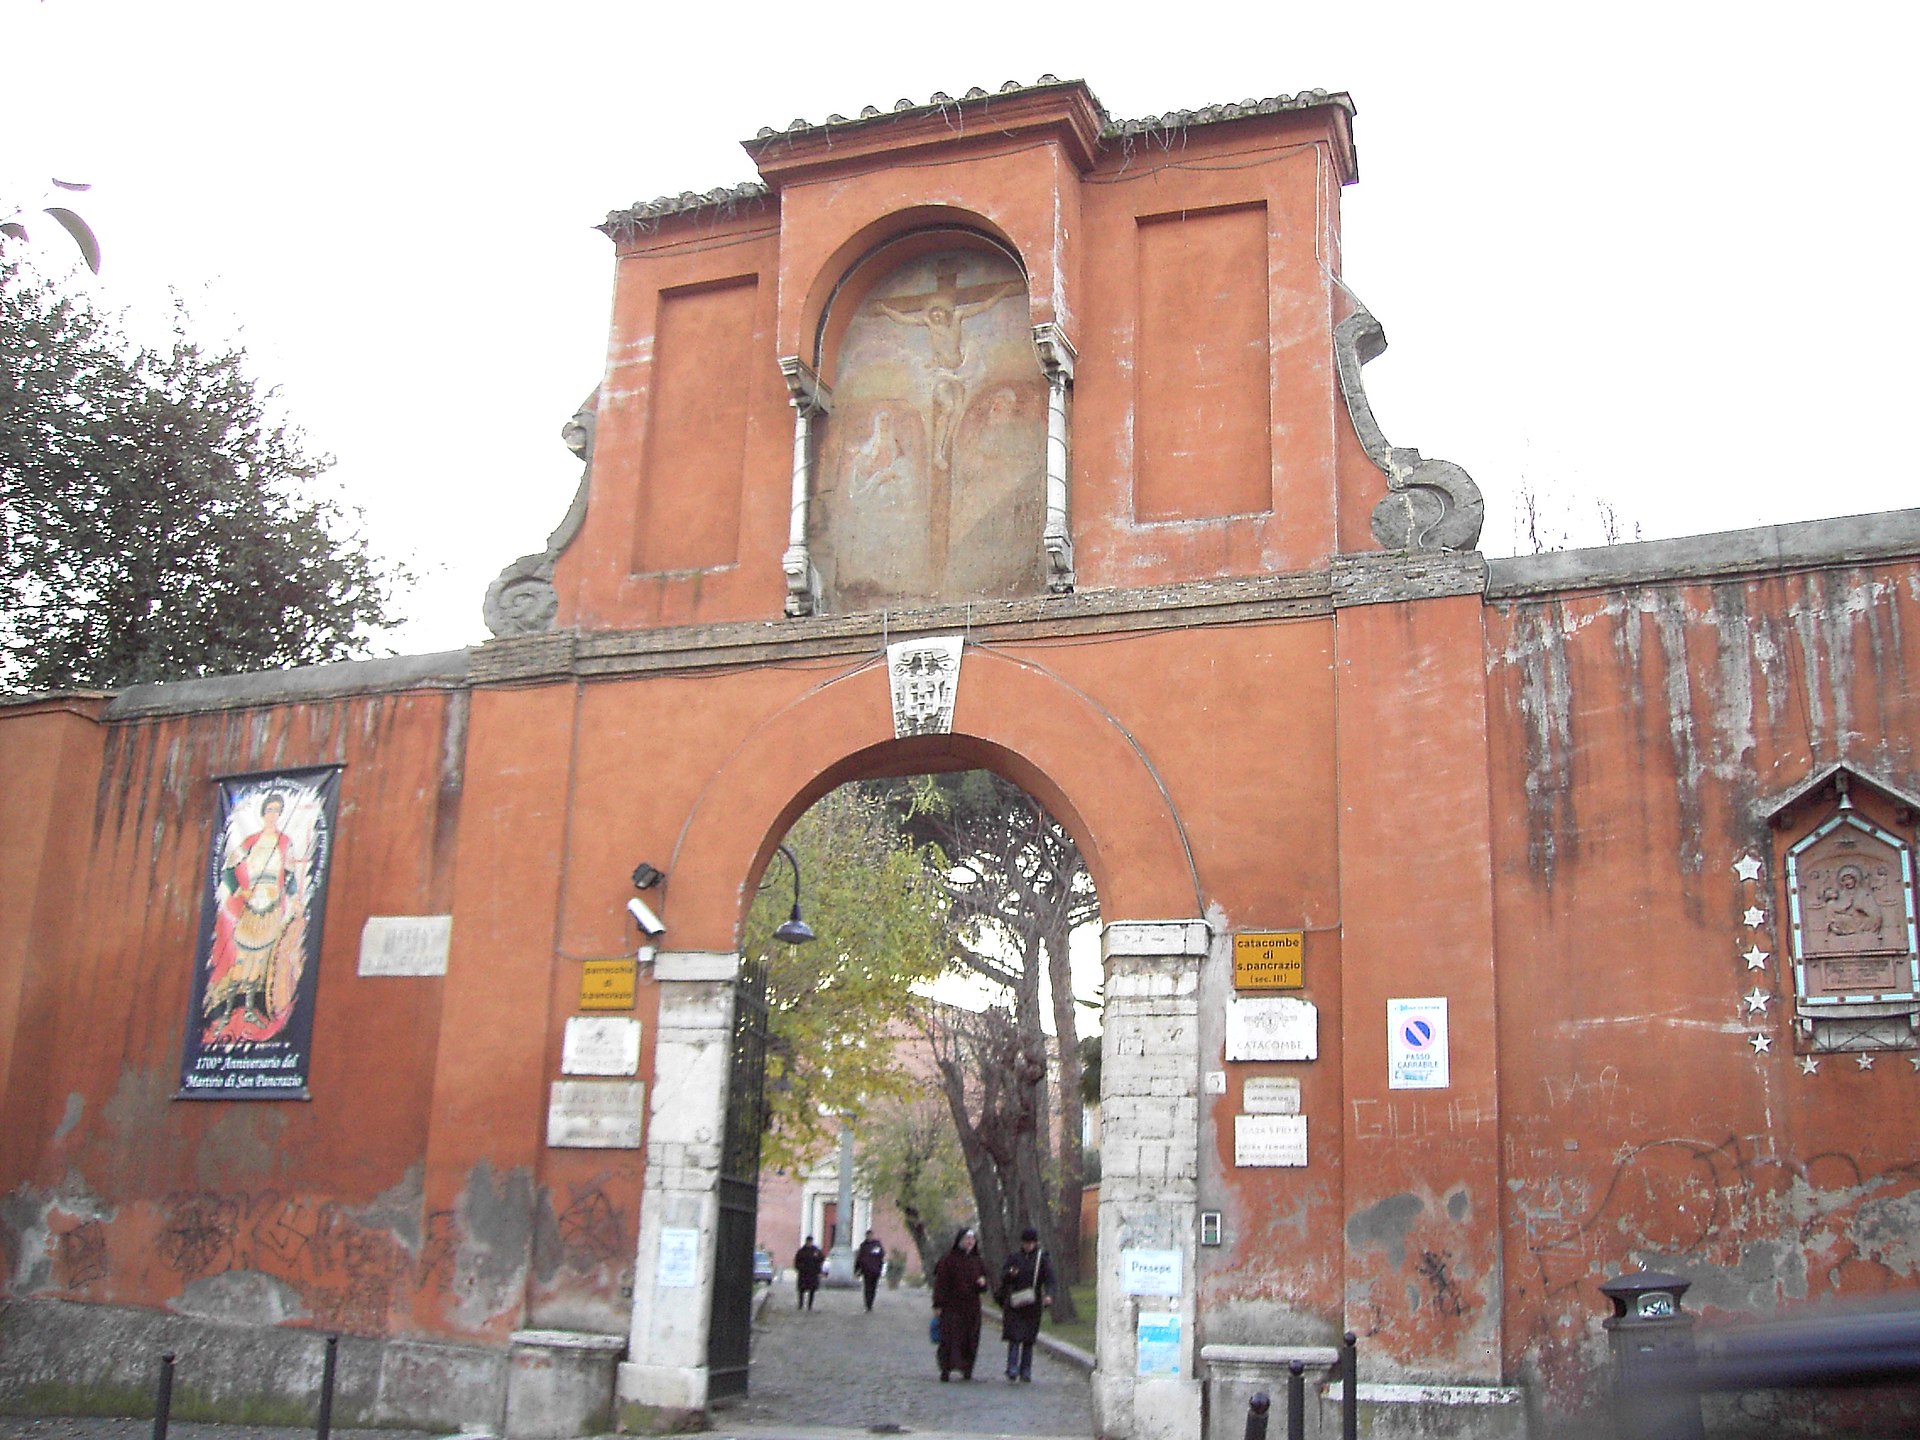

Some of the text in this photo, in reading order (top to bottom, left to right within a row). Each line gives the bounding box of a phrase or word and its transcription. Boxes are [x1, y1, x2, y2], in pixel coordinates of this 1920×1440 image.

[1237, 937, 1299, 948] catacombe
[1263, 950, 1274, 959] di
[1237, 960, 1300, 971] s.pancrazio
[1237, 1041, 1304, 1050] CATACOMBE
[220, 1056, 281, 1071] Anniversario
[1397, 1061, 1439, 1069] CARRABILE
[186, 1072, 303, 1089] Martirio di San Pancrazio
[1131, 1260, 1172, 1275] Presepe
